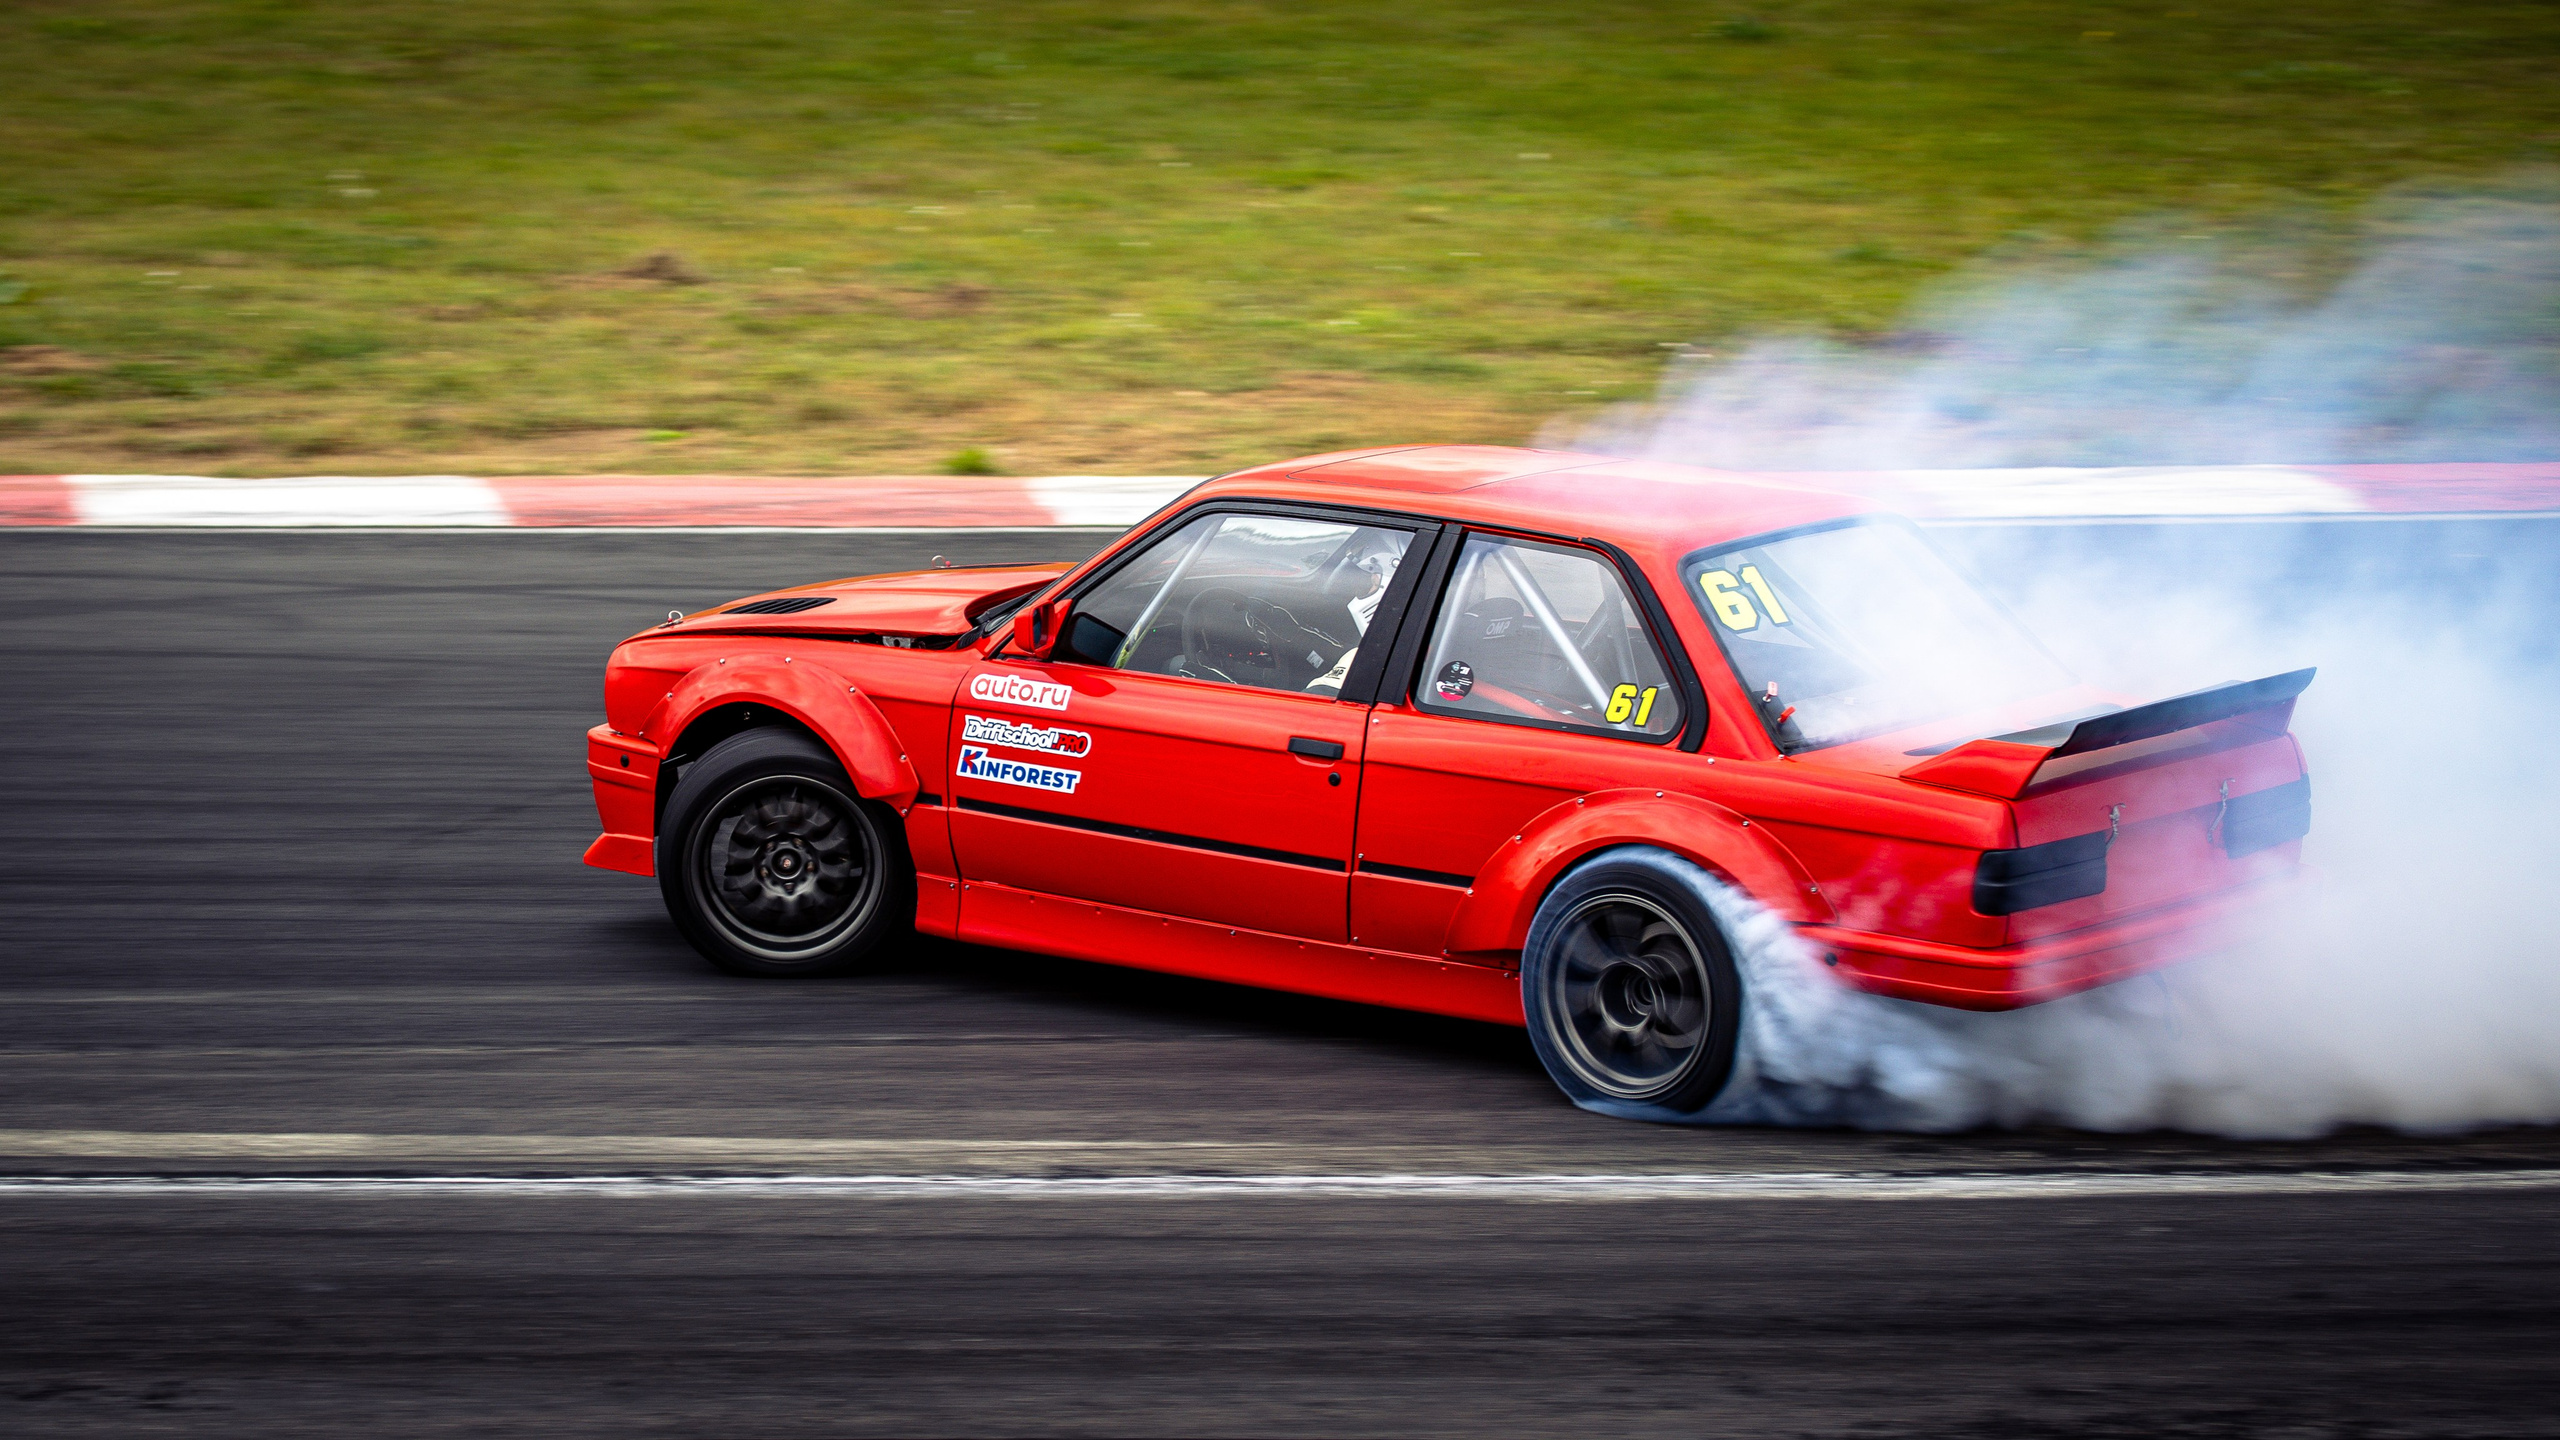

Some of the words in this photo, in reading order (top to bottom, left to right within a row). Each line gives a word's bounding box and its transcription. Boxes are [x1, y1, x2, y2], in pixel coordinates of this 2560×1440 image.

[1697, 563, 1793, 633] 61
[1486, 621, 1511, 635] OMP
[974, 677, 1067, 706] auto.ru
[1604, 683, 1658, 727] 61
